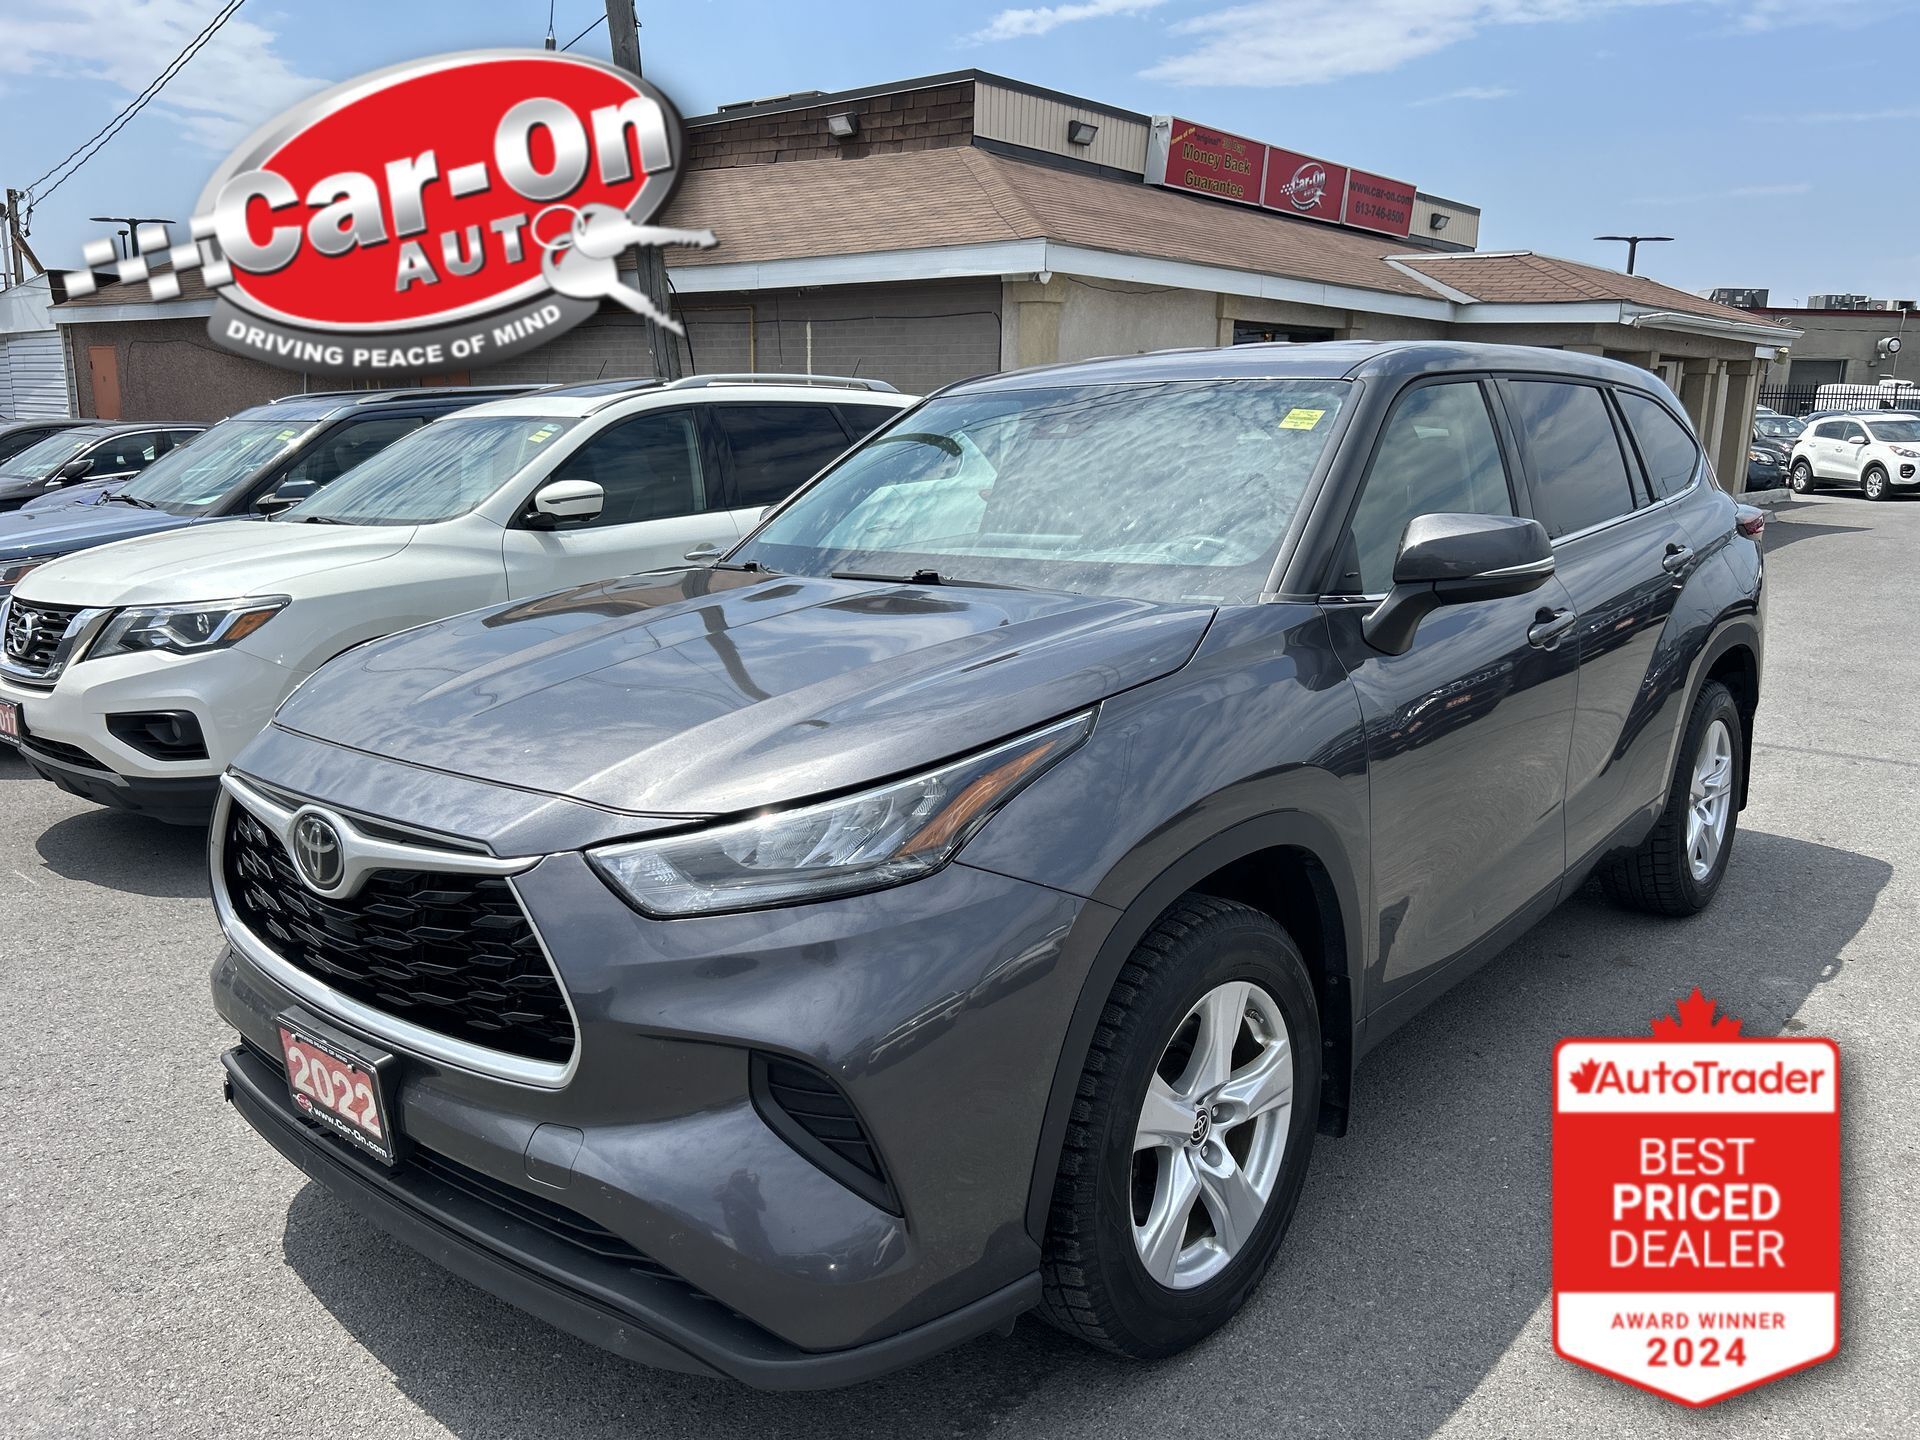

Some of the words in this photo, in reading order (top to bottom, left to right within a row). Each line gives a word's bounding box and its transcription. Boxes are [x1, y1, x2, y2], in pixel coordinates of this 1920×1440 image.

[1182, 141, 1222, 172] Money
[1223, 152, 1251, 176] Back
[1184, 168, 1244, 198] Guarantee
[1291, 170, 1326, 191] Car-On
[288, 1046, 383, 1140] 2022
[313, 1107, 388, 1158] www.Car-On.com
